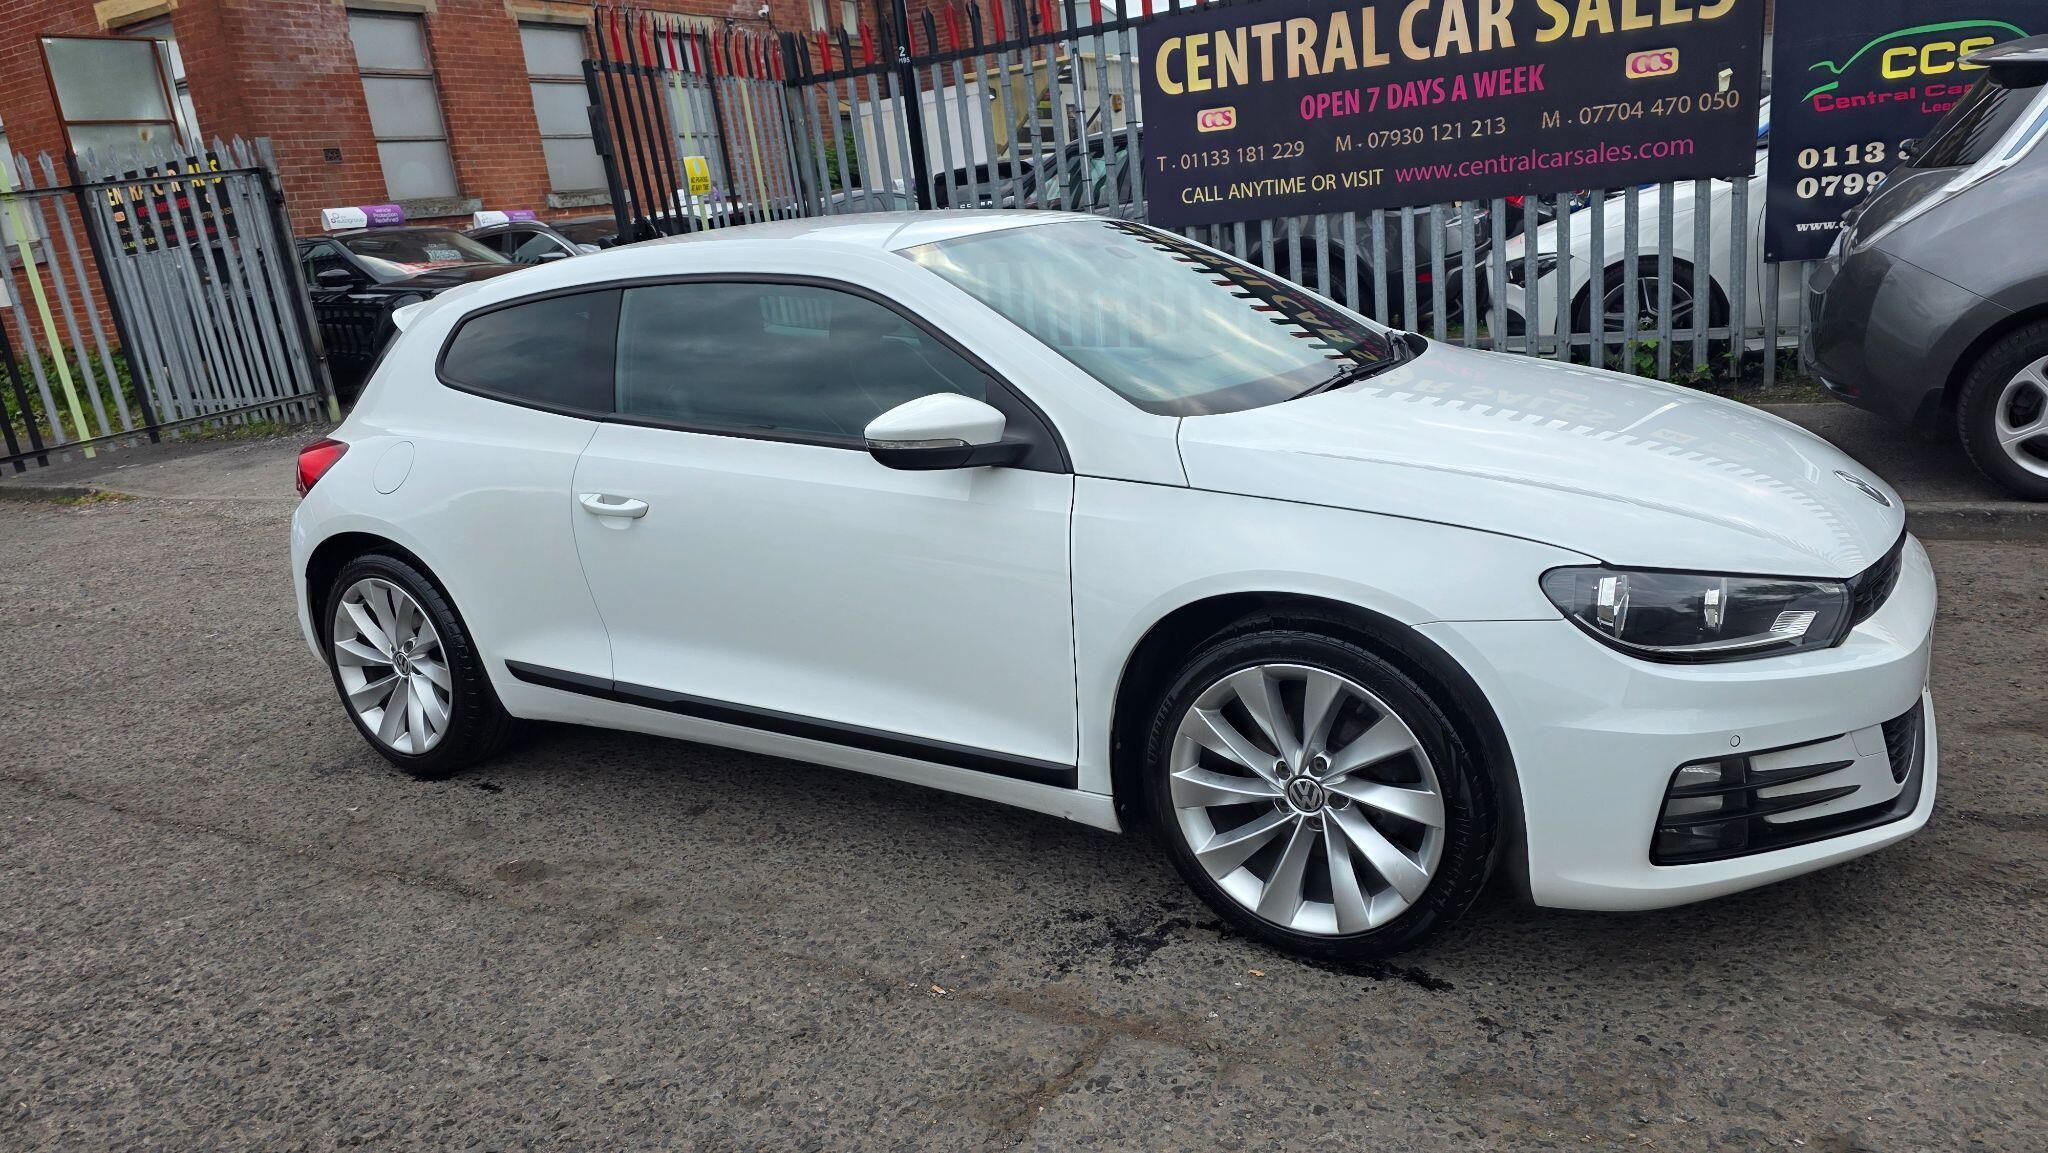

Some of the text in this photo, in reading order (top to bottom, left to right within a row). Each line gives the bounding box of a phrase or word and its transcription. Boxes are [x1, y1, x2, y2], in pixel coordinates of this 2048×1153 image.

[898, 46, 906, 57] 2
[1156, 7, 1390, 95] CENTRAL
[1399, 0, 1515, 61] CAR
[1632, 51, 1674, 74] CCS
[1300, 64, 1545, 120] OPEN 7 DAYS A WEEK
[1579, 101, 1643, 125] 07704
[1650, 95, 1691, 116] 470
[1699, 89, 1740, 112] 050
[1813, 86, 1916, 112] Central
[1200, 109, 1234, 130] CCS
[1368, 126, 1424, 149] 07930
[1431, 122, 1462, 142] 121
[1472, 117, 1506, 137] 213
[1180, 149, 1230, 170] 01133
[1237, 146, 1265, 163] 181
[1272, 140, 1305, 160] 229
[1395, 138, 1695, 183] www.centralcarsales.com
[1798, 141, 1885, 170] 0113
[1182, 168, 1384, 204] CALL ANYTIME OR VISIT
